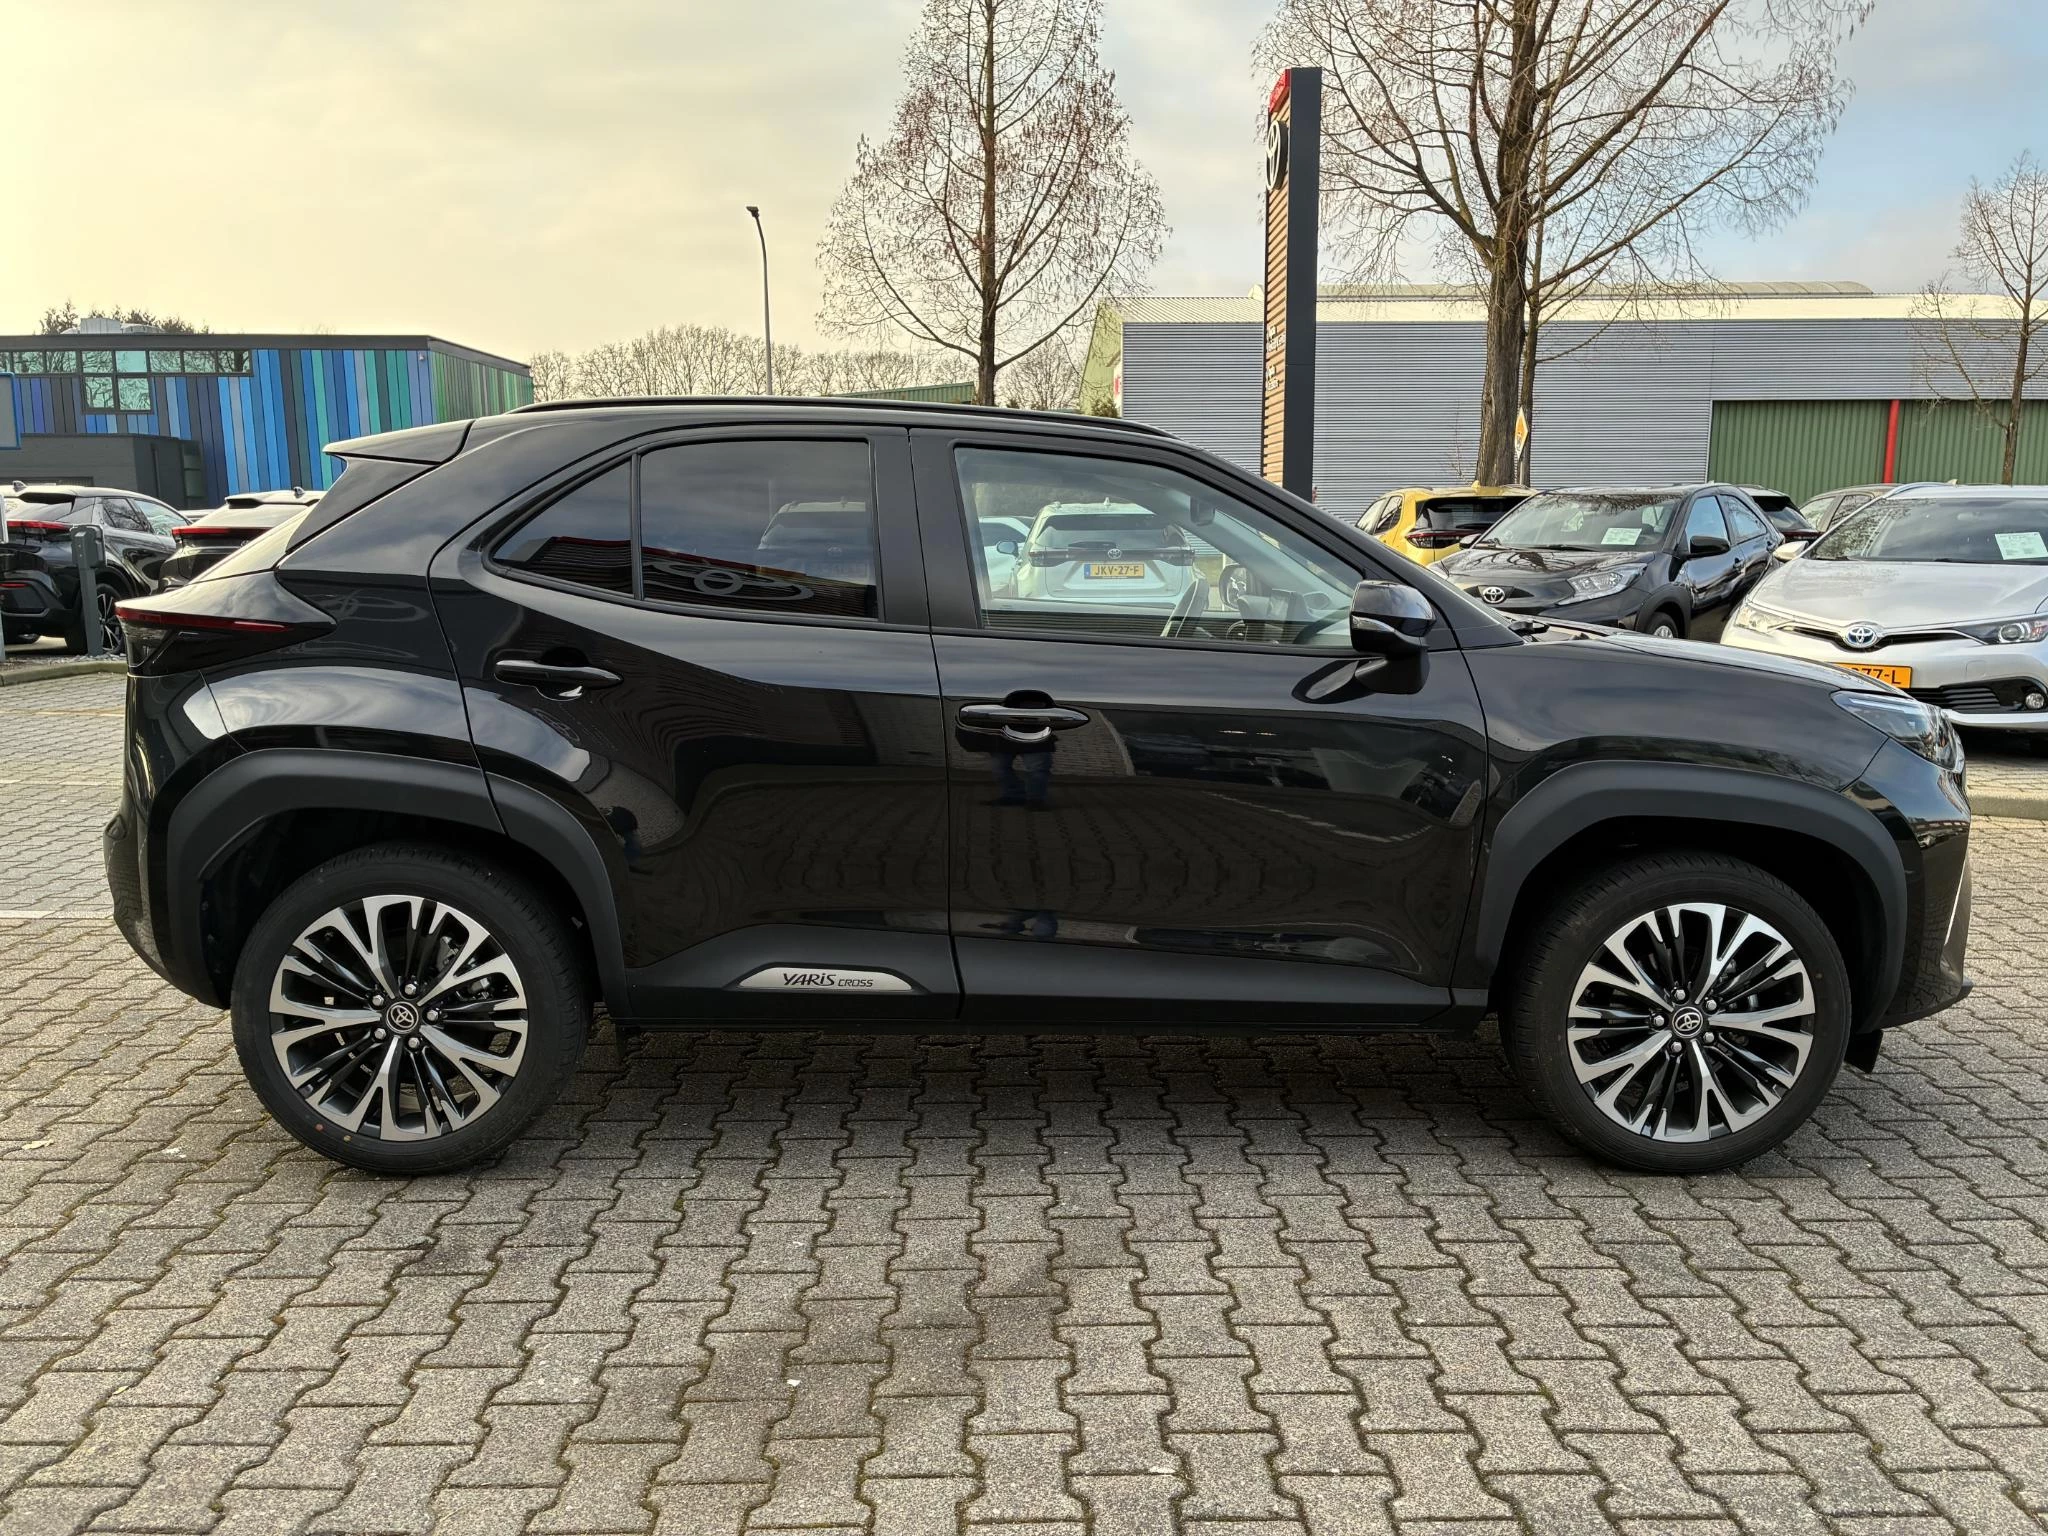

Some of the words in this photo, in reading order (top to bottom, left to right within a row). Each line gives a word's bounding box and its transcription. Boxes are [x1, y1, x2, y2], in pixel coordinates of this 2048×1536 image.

[1094, 565, 1140, 576] JKV-27-F
[1851, 667, 1902, 684] 77-L
[837, 979, 874, 988] CROSS
